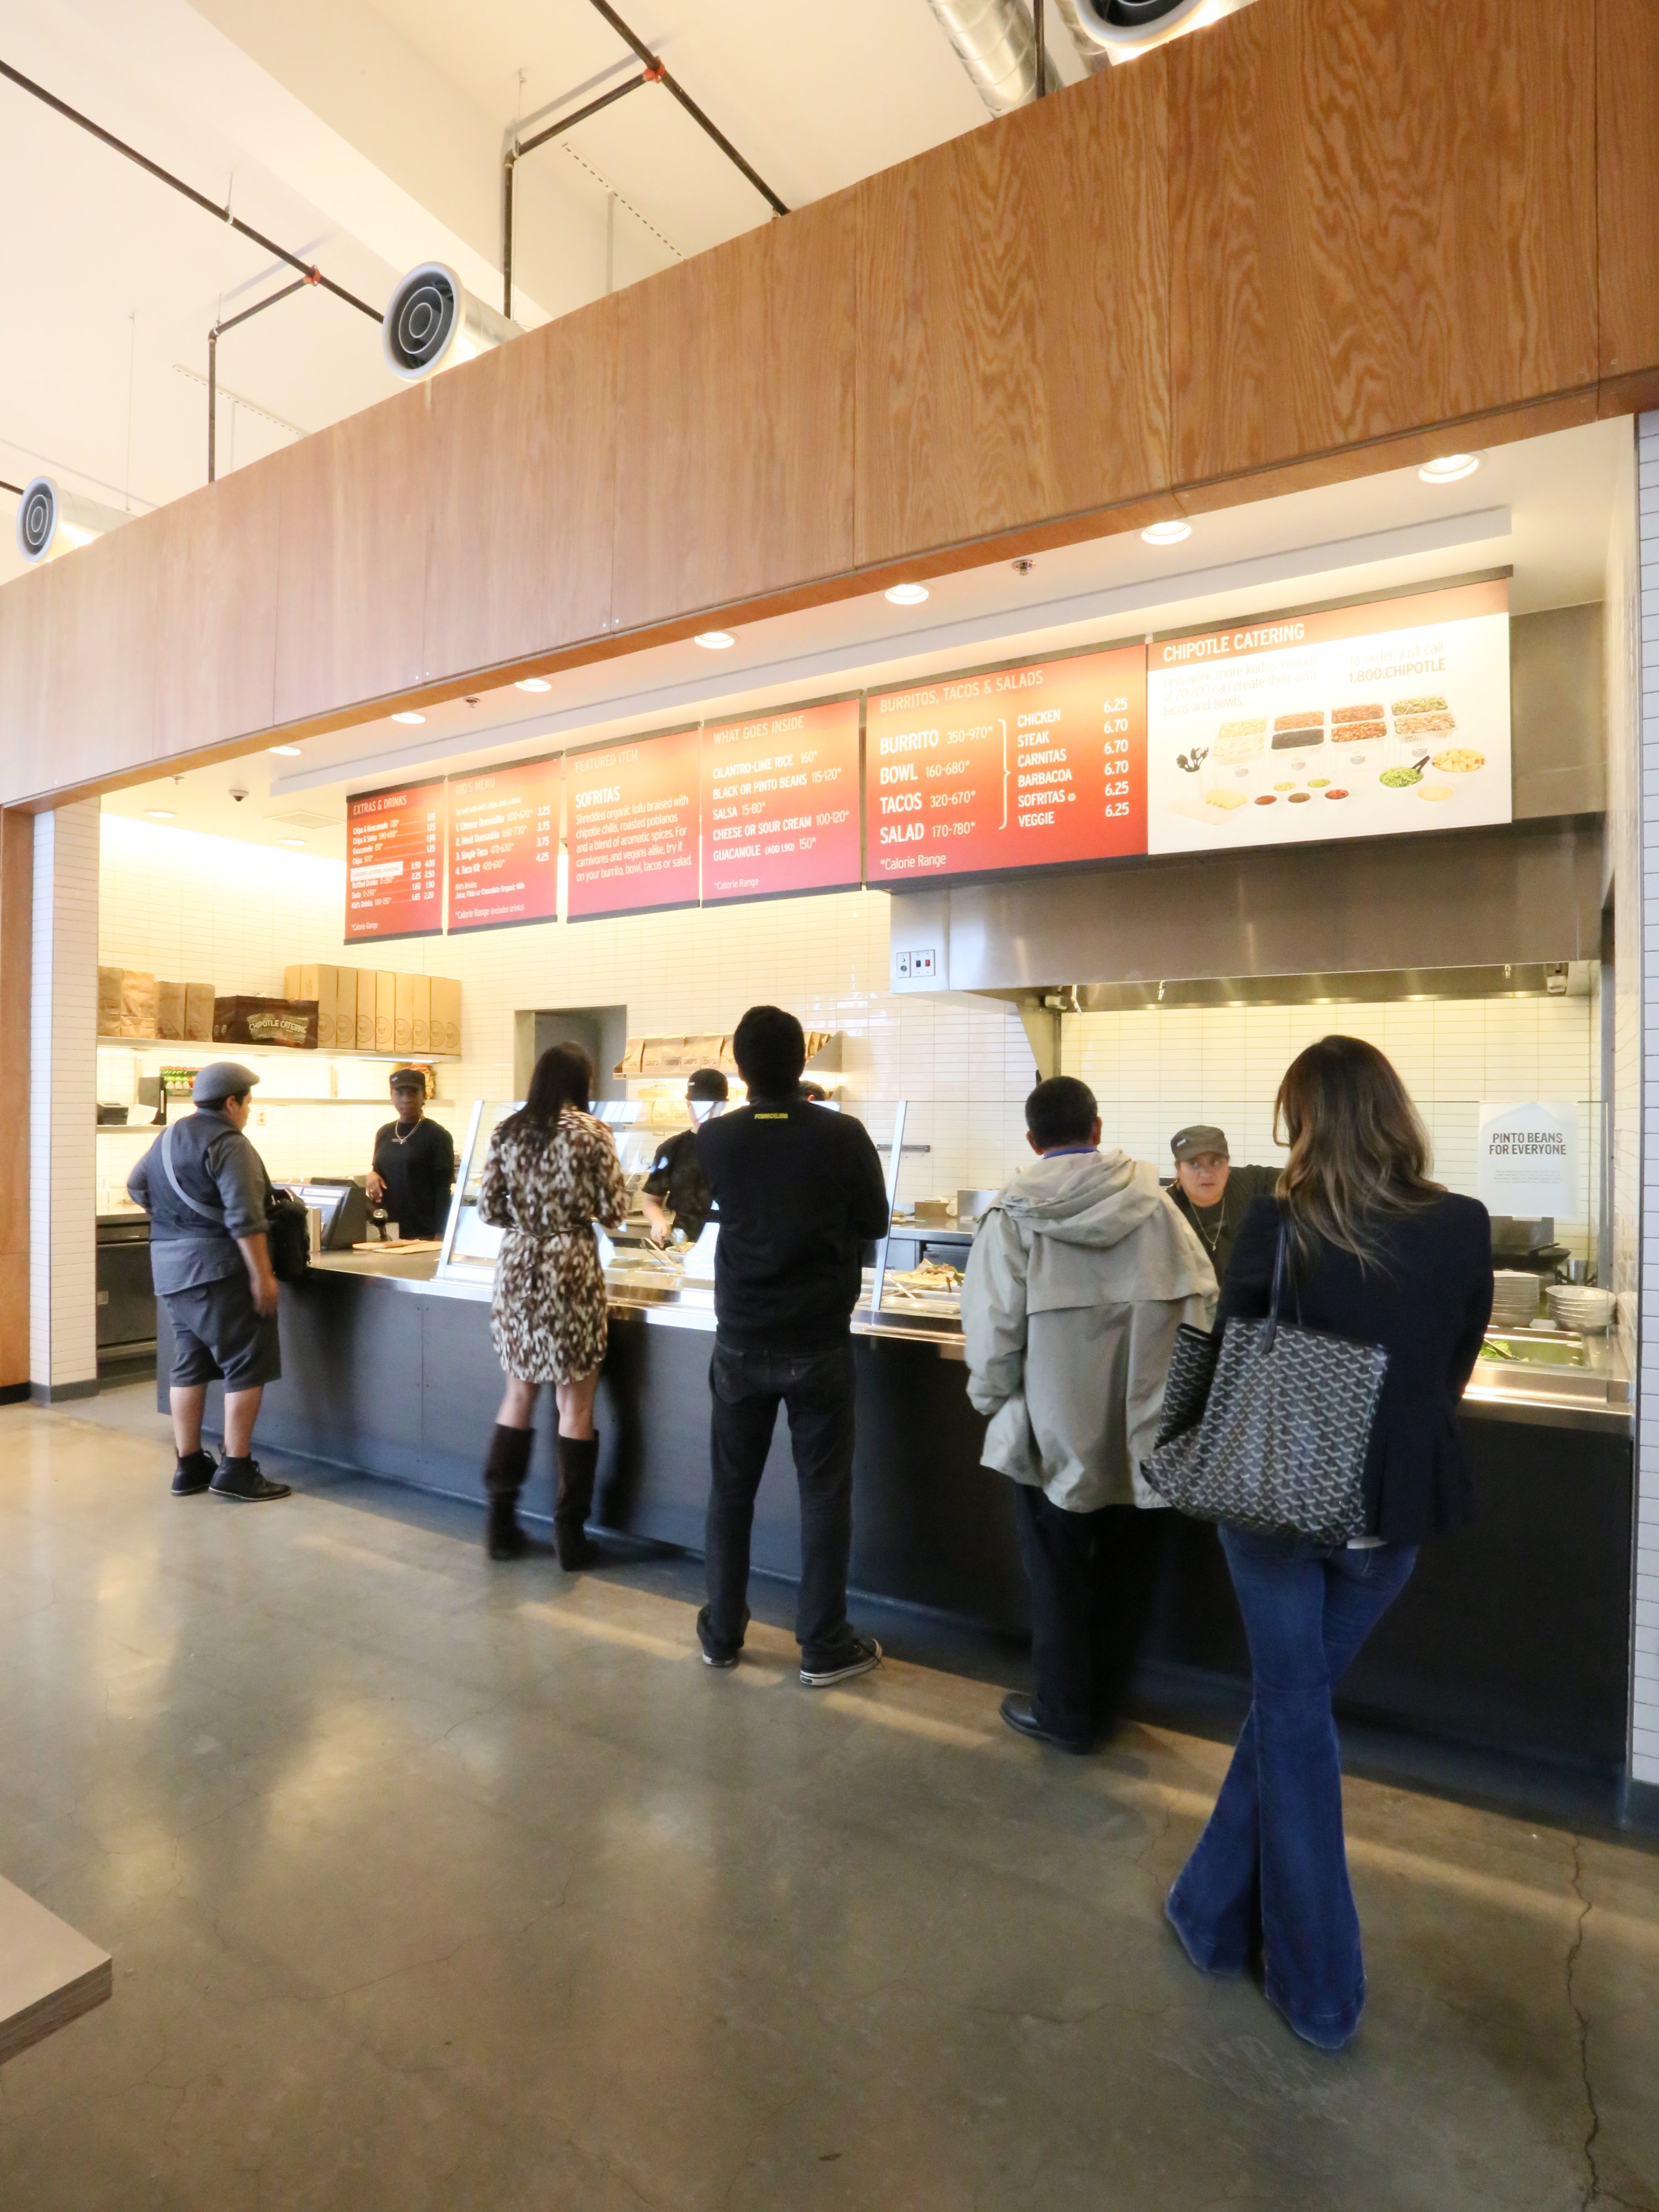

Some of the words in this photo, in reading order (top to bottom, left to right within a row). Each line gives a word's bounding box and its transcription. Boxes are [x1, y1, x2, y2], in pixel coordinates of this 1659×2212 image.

[1164, 637, 1229, 661] CHIPOTLE
[1234, 623, 1305, 650] CATERING
[1349, 653, 1360, 666] To
[1364, 649, 1396, 665] order,
[1399, 644, 1420, 661] just
[1423, 641, 1443, 655] call
[1164, 675, 1185, 688] Less
[1187, 670, 1213, 685] work,
[1217, 667, 1242, 680] more
[1246, 660, 1278, 675] kudos.
[1281, 654, 1318, 672] Groups
[1349, 659, 1446, 684] 1.800.CHIPOTLE
[880, 691, 938, 714] BURRITOS,
[943, 682, 979, 701] TACOS
[983, 679, 991, 694] &
[996, 670, 1043, 692] SALADS
[1164, 690, 1173, 702] of
[1213, 684, 1230, 694] can
[1233, 678, 1265, 690] create
[1269, 672, 1291, 686] their
[1295, 670, 1316, 681] own
[1103, 697, 1127, 714] 6.25
[1164, 703, 1188, 716] tacos
[1192, 700, 1211, 712] and
[1213, 695, 1244, 708] bowls.
[1018, 709, 1060, 727] CHICKEN
[1103, 718, 1128, 734] 6.70
[714, 728, 739, 745] WHAT
[743, 723, 768, 739] GOES
[772, 716, 804, 733] INSIDE
[1018, 731, 1049, 747] STEAK
[880, 729, 938, 755] BURRITO
[1104, 738, 1128, 755] 6.70
[575, 754, 615, 772] FEATURED
[619, 749, 638, 764] ITEM
[713, 759, 771, 779] CILANTRO-LIME
[775, 754, 793, 768] RICE
[1018, 749, 1066, 767] CARNITAS
[1104, 760, 1128, 776] 6.70
[880, 763, 918, 785] BOWL
[1018, 768, 1072, 787] BARBACOA
[455, 782, 472, 796] KID'S
[475, 778, 495, 791] MENU
[576, 786, 619, 808] SOFRITAS
[713, 785, 738, 800] BLACK
[740, 782, 751, 795] OR
[753, 778, 777, 793] PINTO
[779, 774, 806, 789] BEANS
[1104, 781, 1129, 796] 6.25
[353, 802, 375, 815] EXTRAS
[378, 800, 382, 810] &
[383, 795, 406, 808] DRINKS
[880, 792, 922, 815] TACOS
[1018, 790, 1065, 807] SOFRITAS
[455, 822, 459, 831] 1.
[460, 820, 478, 831] Cheese
[479, 815, 504, 826] Quesadilla
[536, 805, 550, 816] 3.25
[576, 811, 606, 825] Shredded
[607, 806, 630, 821] organic
[632, 801, 645, 815] tofu
[646, 797, 672, 812] braised
[674, 794, 688, 807] with
[713, 806, 737, 820] SALSA
[1018, 812, 1055, 827] VEGGIE
[1105, 802, 1129, 817] 6.25
[455, 837, 460, 846] 2.
[461, 835, 473, 844] Meat
[474, 830, 499, 842] Quesadilla
[536, 821, 550, 832] 3.75
[576, 825, 600, 841] chipotle
[620, 817, 645, 831] roasted
[647, 812, 677, 828] poblanos
[713, 827, 742, 841] CHEESE
[744, 824, 756, 837] OR
[758, 821, 780, 834] SOUR
[782, 816, 811, 830] CREAM
[880, 823, 924, 844] SALAD
[455, 852, 460, 860] 3.
[461, 849, 476, 860] Single
[477, 847, 488, 857] Taco
[536, 836, 549, 847] 3.75
[576, 842, 587, 853] and
[589, 843, 592, 851] a
[594, 838, 611, 850] blend
[613, 836, 619, 847] of
[621, 832, 650, 845] aromatic
[651, 829, 673, 842] spices.
[675, 825, 687, 837] For
[576, 854, 608, 867] carnivores
[610, 851, 622, 862] and
[623, 848, 646, 862] vegans
[648, 844, 665, 857] alike,
[666, 841, 676, 854] try
[677, 840, 683, 851] it
[713, 846, 760, 861] GUACAMOLE
[765, 844, 779, 855] (ADD
[917, 852, 946, 868] Range
[410, 860, 421, 869] 3.50
[424, 858, 435, 867] 4.00
[424, 869, 435, 878] 2.50
[455, 867, 460, 875] 4.
[461, 865, 472, 874] Taco
[536, 852, 549, 862] 4.25
[576, 873, 584, 882] on
[586, 870, 599, 883] your
[601, 865, 624, 878] burrito,
[625, 863, 642, 874] bowl,
[644, 860, 661, 872] tacos
[664, 859, 671, 869] or
[672, 854, 692, 868] salad.
[412, 882, 421, 890] 1.60
[425, 880, 435, 888] 1.90
[739, 877, 759, 889] Range
[424, 891, 434, 899] 2.20
[474, 907, 489, 918] Range
[249, 1020, 279, 1030] CHIPOTLE
[280, 1020, 307, 1033] CATERING
[1493, 1133, 1524, 1144] PINTO
[1527, 1133, 1563, 1144] BEANS
[1489, 1144, 1509, 1155] FOR
[1511, 1144, 1567, 1155] EVERYONE
